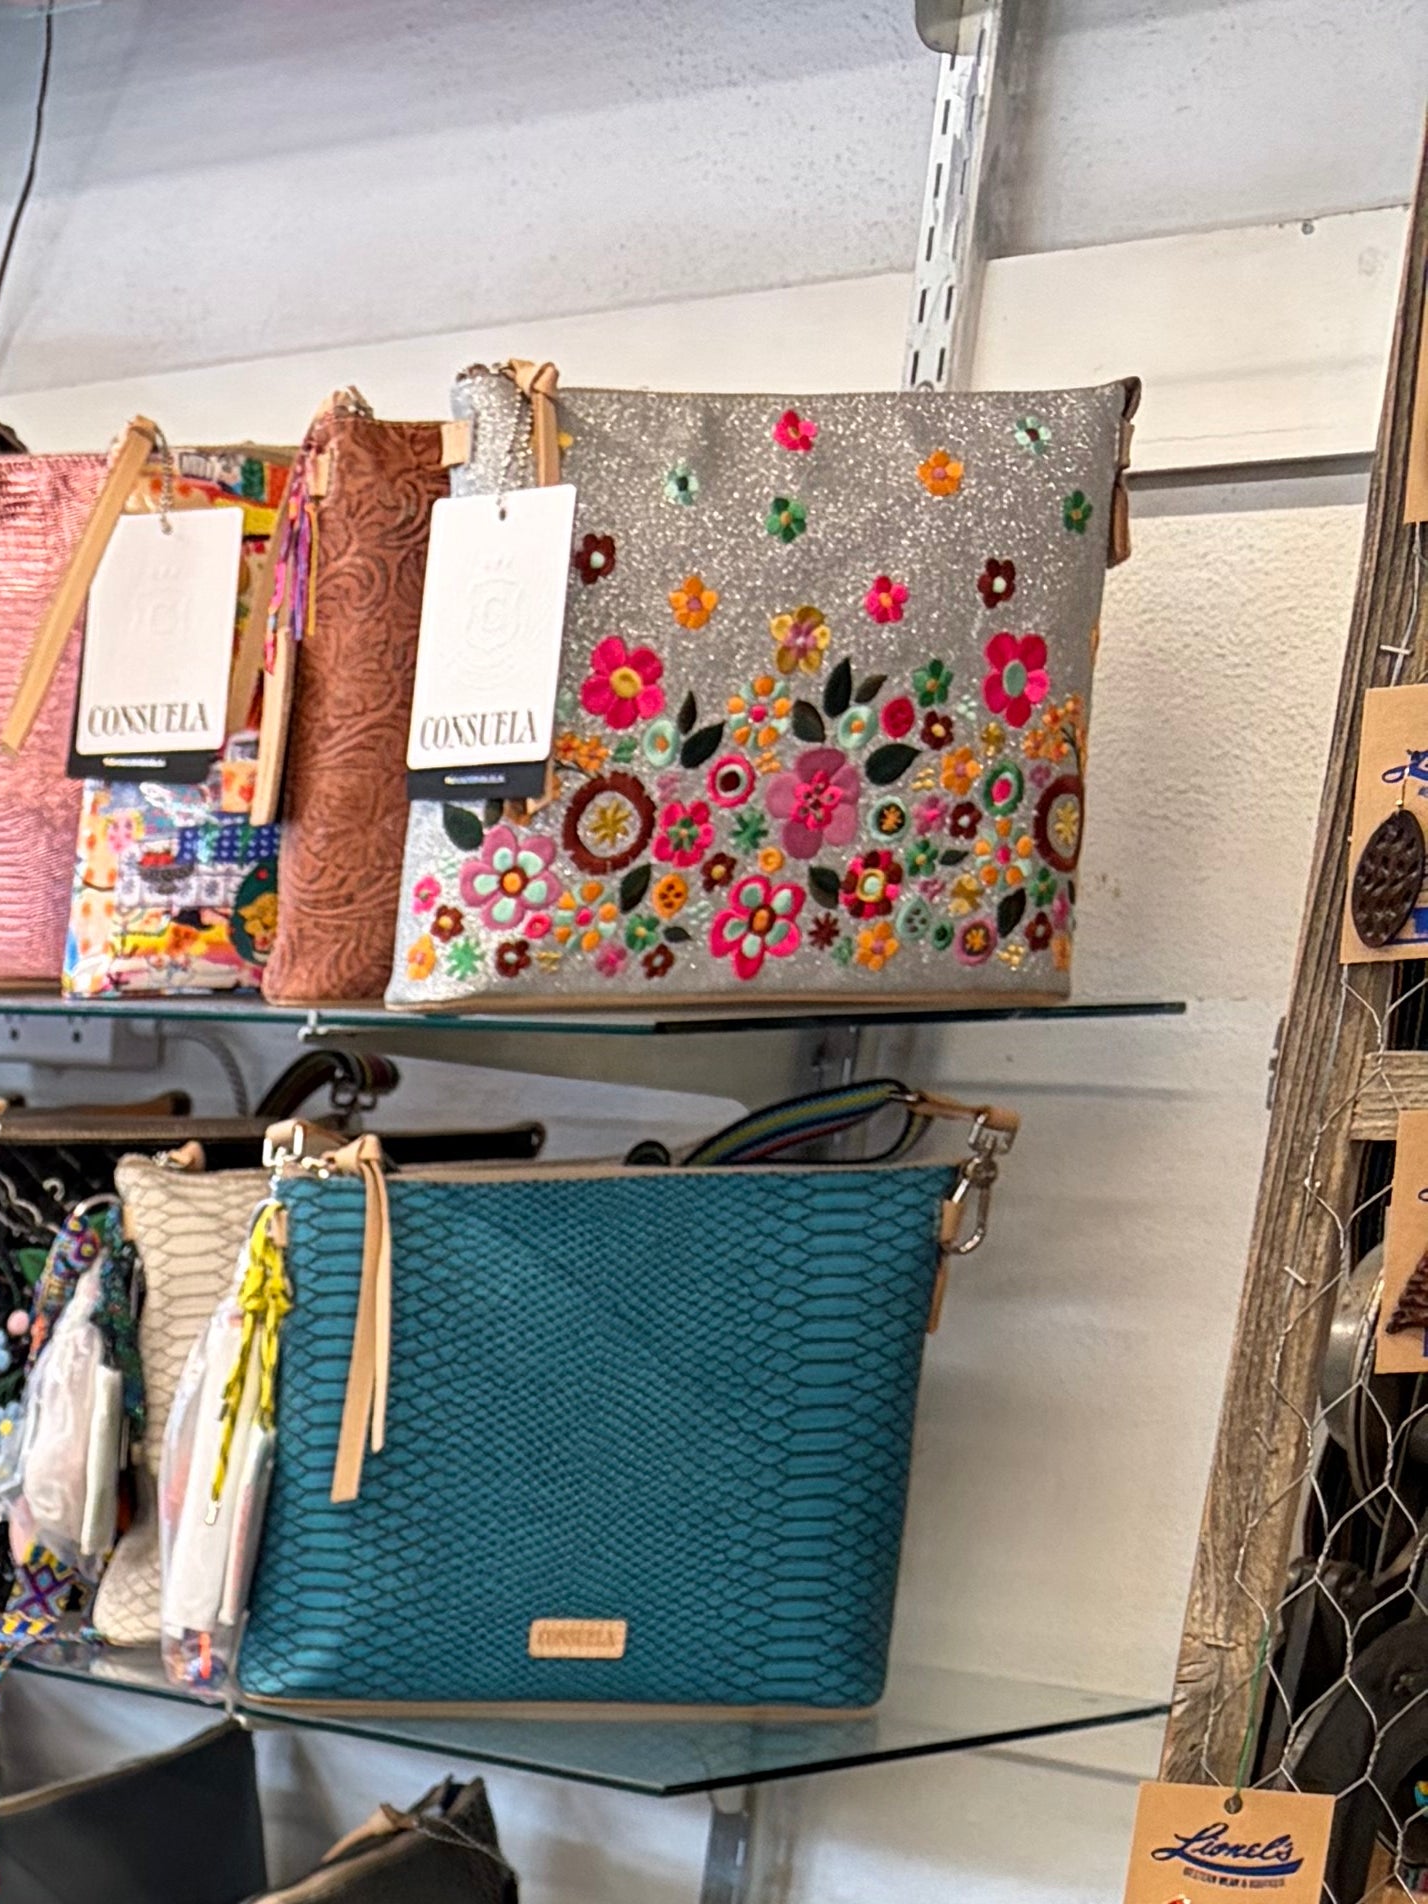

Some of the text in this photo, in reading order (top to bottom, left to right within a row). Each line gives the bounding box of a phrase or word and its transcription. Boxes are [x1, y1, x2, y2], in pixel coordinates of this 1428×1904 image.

[87, 702, 210, 738] CONSUELA
[419, 709, 538, 751] CONSUELA
[1152, 1822, 1296, 1865] Lionel's
